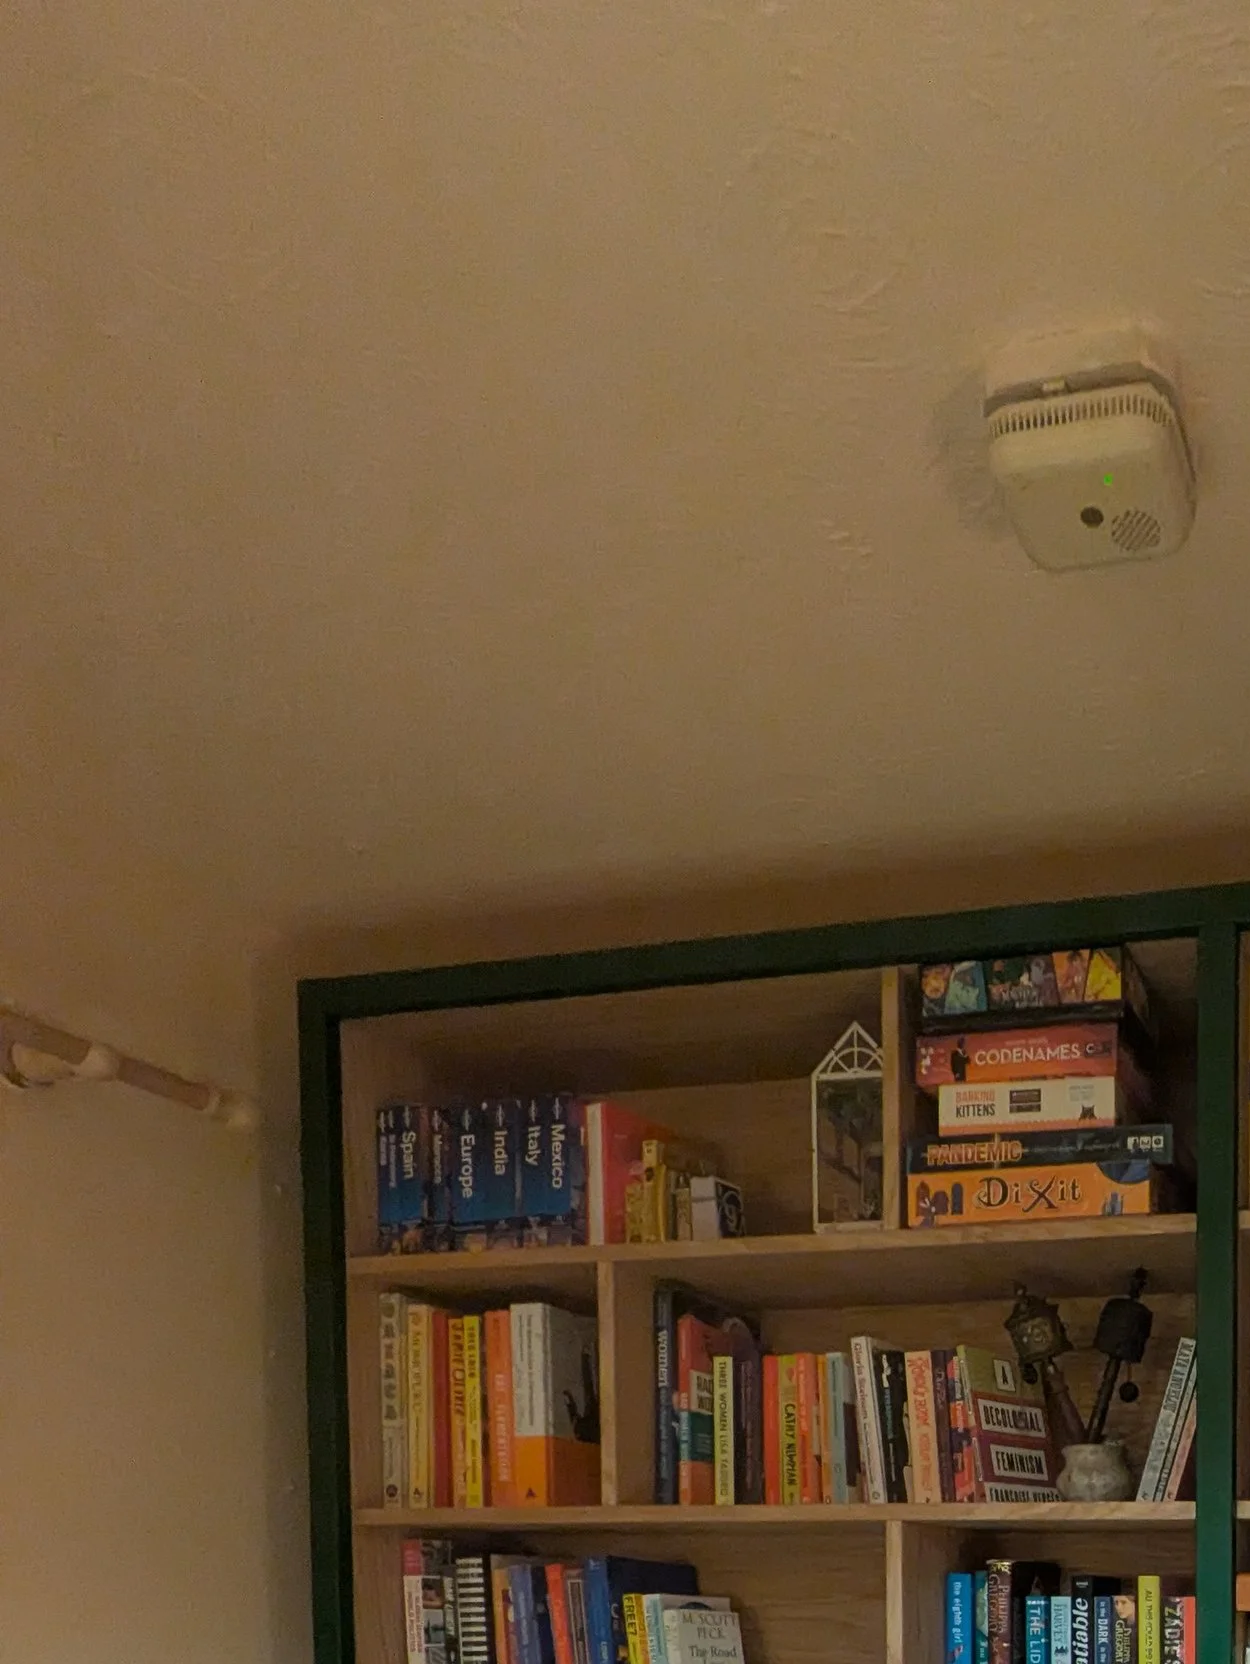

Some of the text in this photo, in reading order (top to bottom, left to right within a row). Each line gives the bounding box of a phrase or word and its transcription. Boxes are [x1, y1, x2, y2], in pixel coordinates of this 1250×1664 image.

[975, 1044, 1080, 1066] CODENAMES
[956, 1104, 995, 1118] KITTENS
[400, 1131, 415, 1178] Spain
[460, 1134, 475, 1198] Europe
[494, 1130, 508, 1176] India
[526, 1126, 541, 1166] Italy
[550, 1124, 566, 1188] Mexico
[927, 1140, 1024, 1166] PANDEMIC
[658, 1329, 669, 1388] women
[719, 1362, 727, 1388] THREE
[720, 1394, 728, 1431] WOMEN
[785, 1404, 796, 1485] CATHY NEWMAN
[996, 1451, 1044, 1475] FEMINISM
[625, 1596, 638, 1636] FREE?
[952, 1582, 963, 1643] the eighth girl
[988, 1574, 999, 1633] GREGORY
[999, 1585, 1008, 1633] PHILIPPA
[1029, 1608, 1041, 1635] THE
[1054, 1603, 1063, 1645] HARVEY
[1115, 1620, 1124, 1663] GREGORY
[1122, 1628, 1132, 1663] PHILIPPA
[1164, 1606, 1181, 1652] ZADIE
[689, 1646, 707, 1657] The
